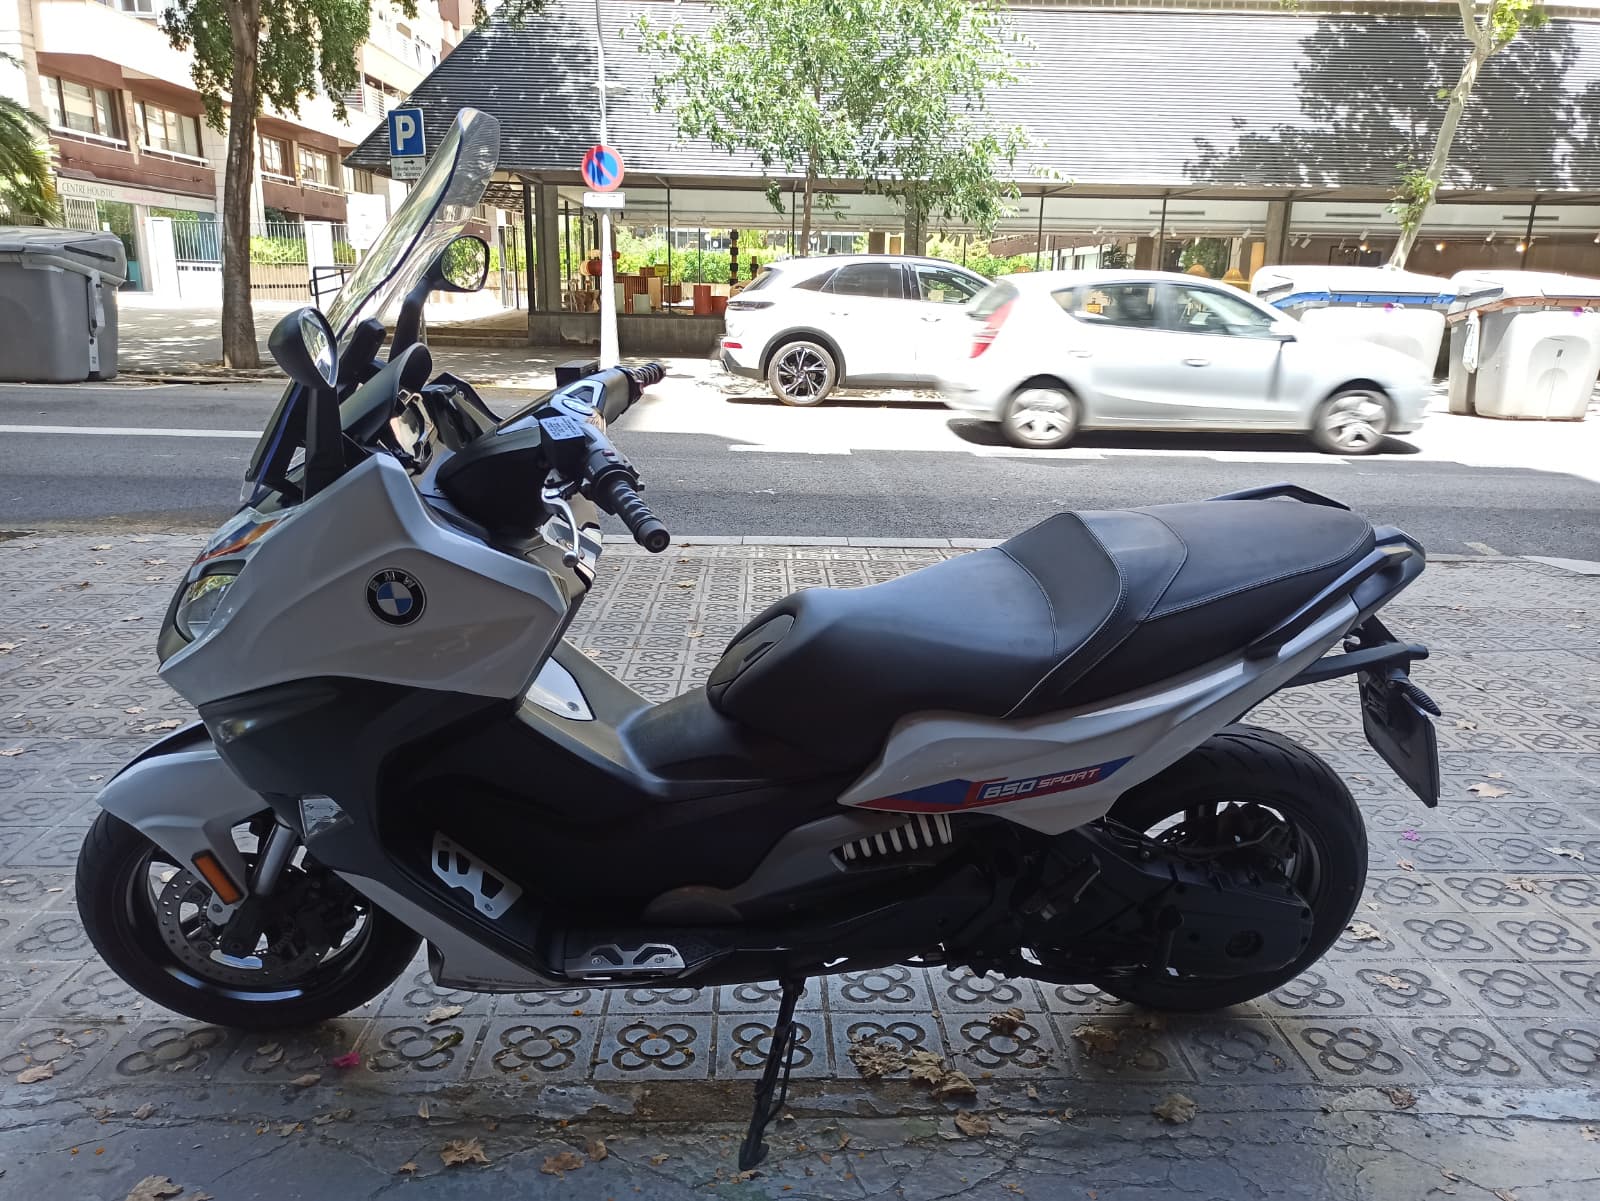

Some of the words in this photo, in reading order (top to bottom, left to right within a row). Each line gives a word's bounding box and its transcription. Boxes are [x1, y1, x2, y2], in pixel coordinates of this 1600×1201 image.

[395, 115, 416, 151] P
[61, 182, 86, 194] CENTRE
[370, 571, 417, 592] BMW
[983, 779, 1038, 799] 650
[1037, 767, 1101, 789] SPORT
